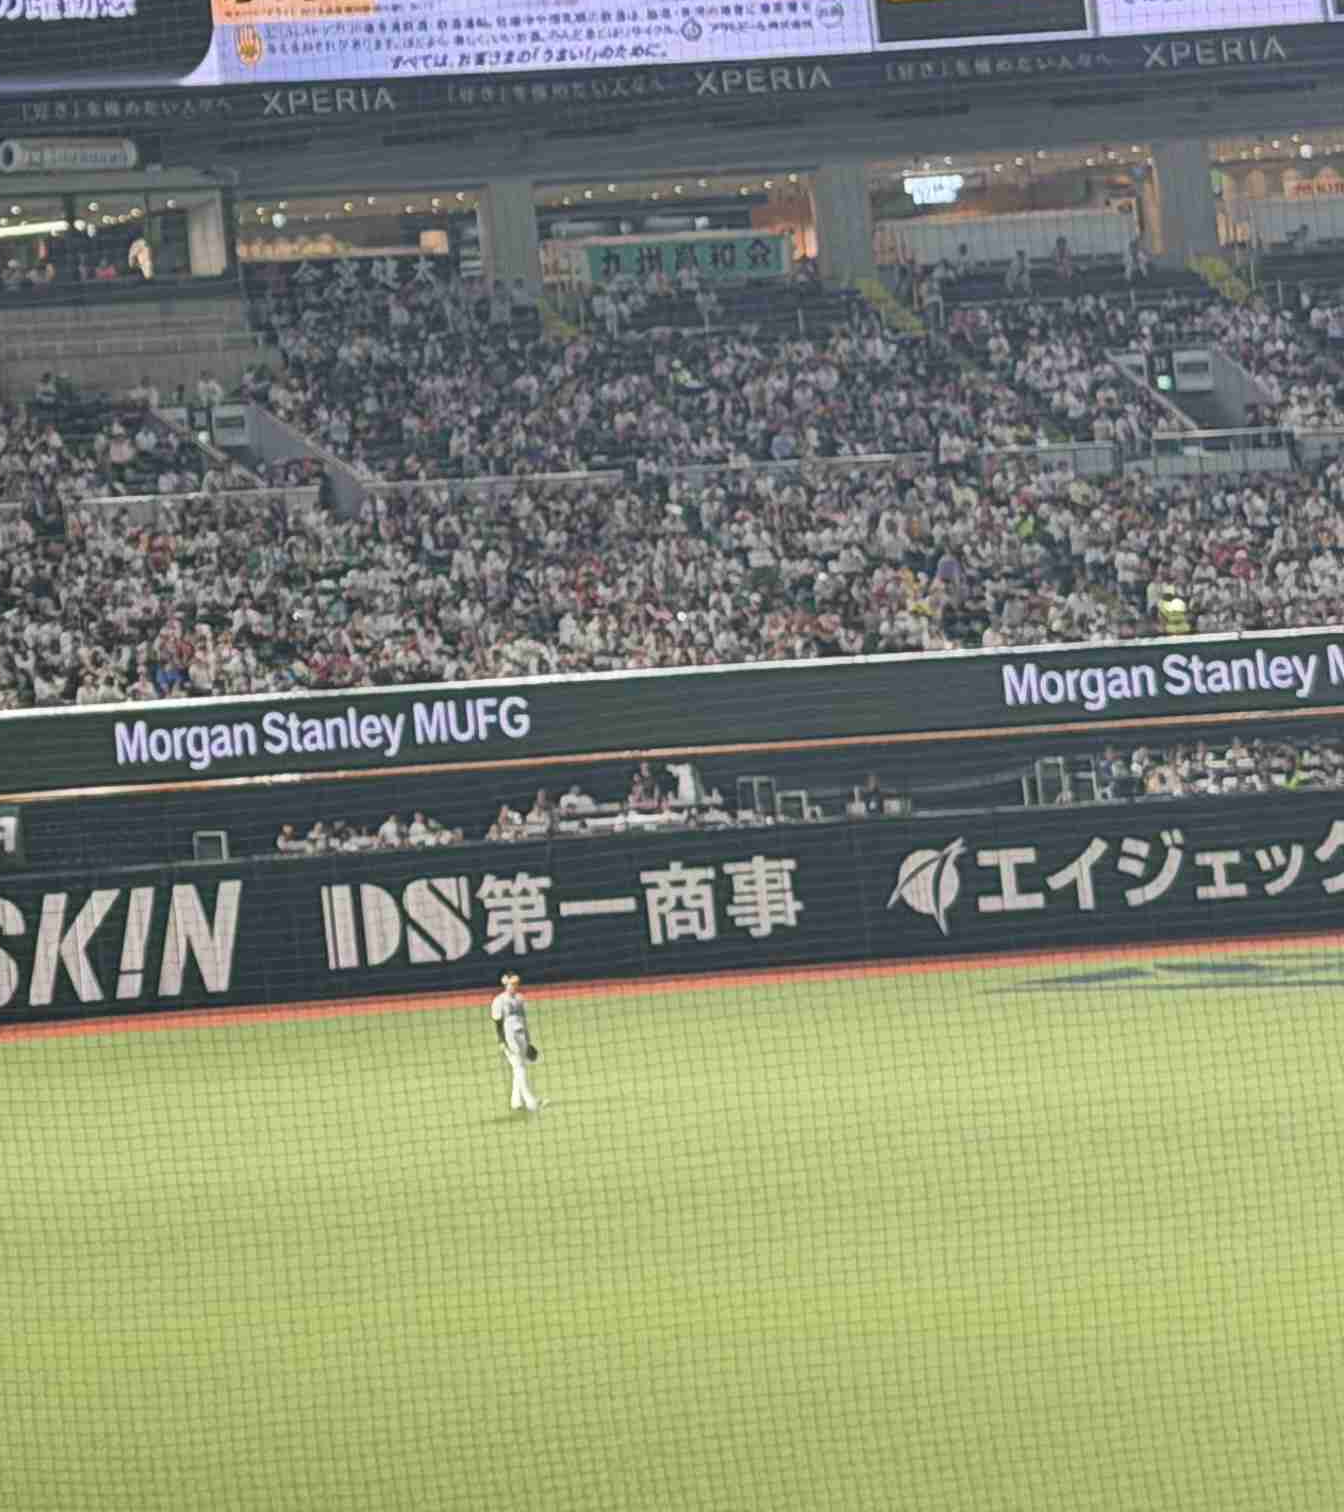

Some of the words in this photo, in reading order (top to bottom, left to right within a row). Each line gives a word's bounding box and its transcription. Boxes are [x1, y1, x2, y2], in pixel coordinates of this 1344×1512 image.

[1142, 34, 1288, 69] XPERIA
[261, 86, 397, 117] XPERIA
[693, 64, 832, 97] XPERIA
[1002, 663, 1155, 711] Morgan
[1161, 648, 1318, 698] Stanley
[114, 719, 257, 771] Morgan
[262, 707, 405, 757] Stanley
[413, 695, 532, 746] MUFG
[475, 854, 804, 957] 第一商事
